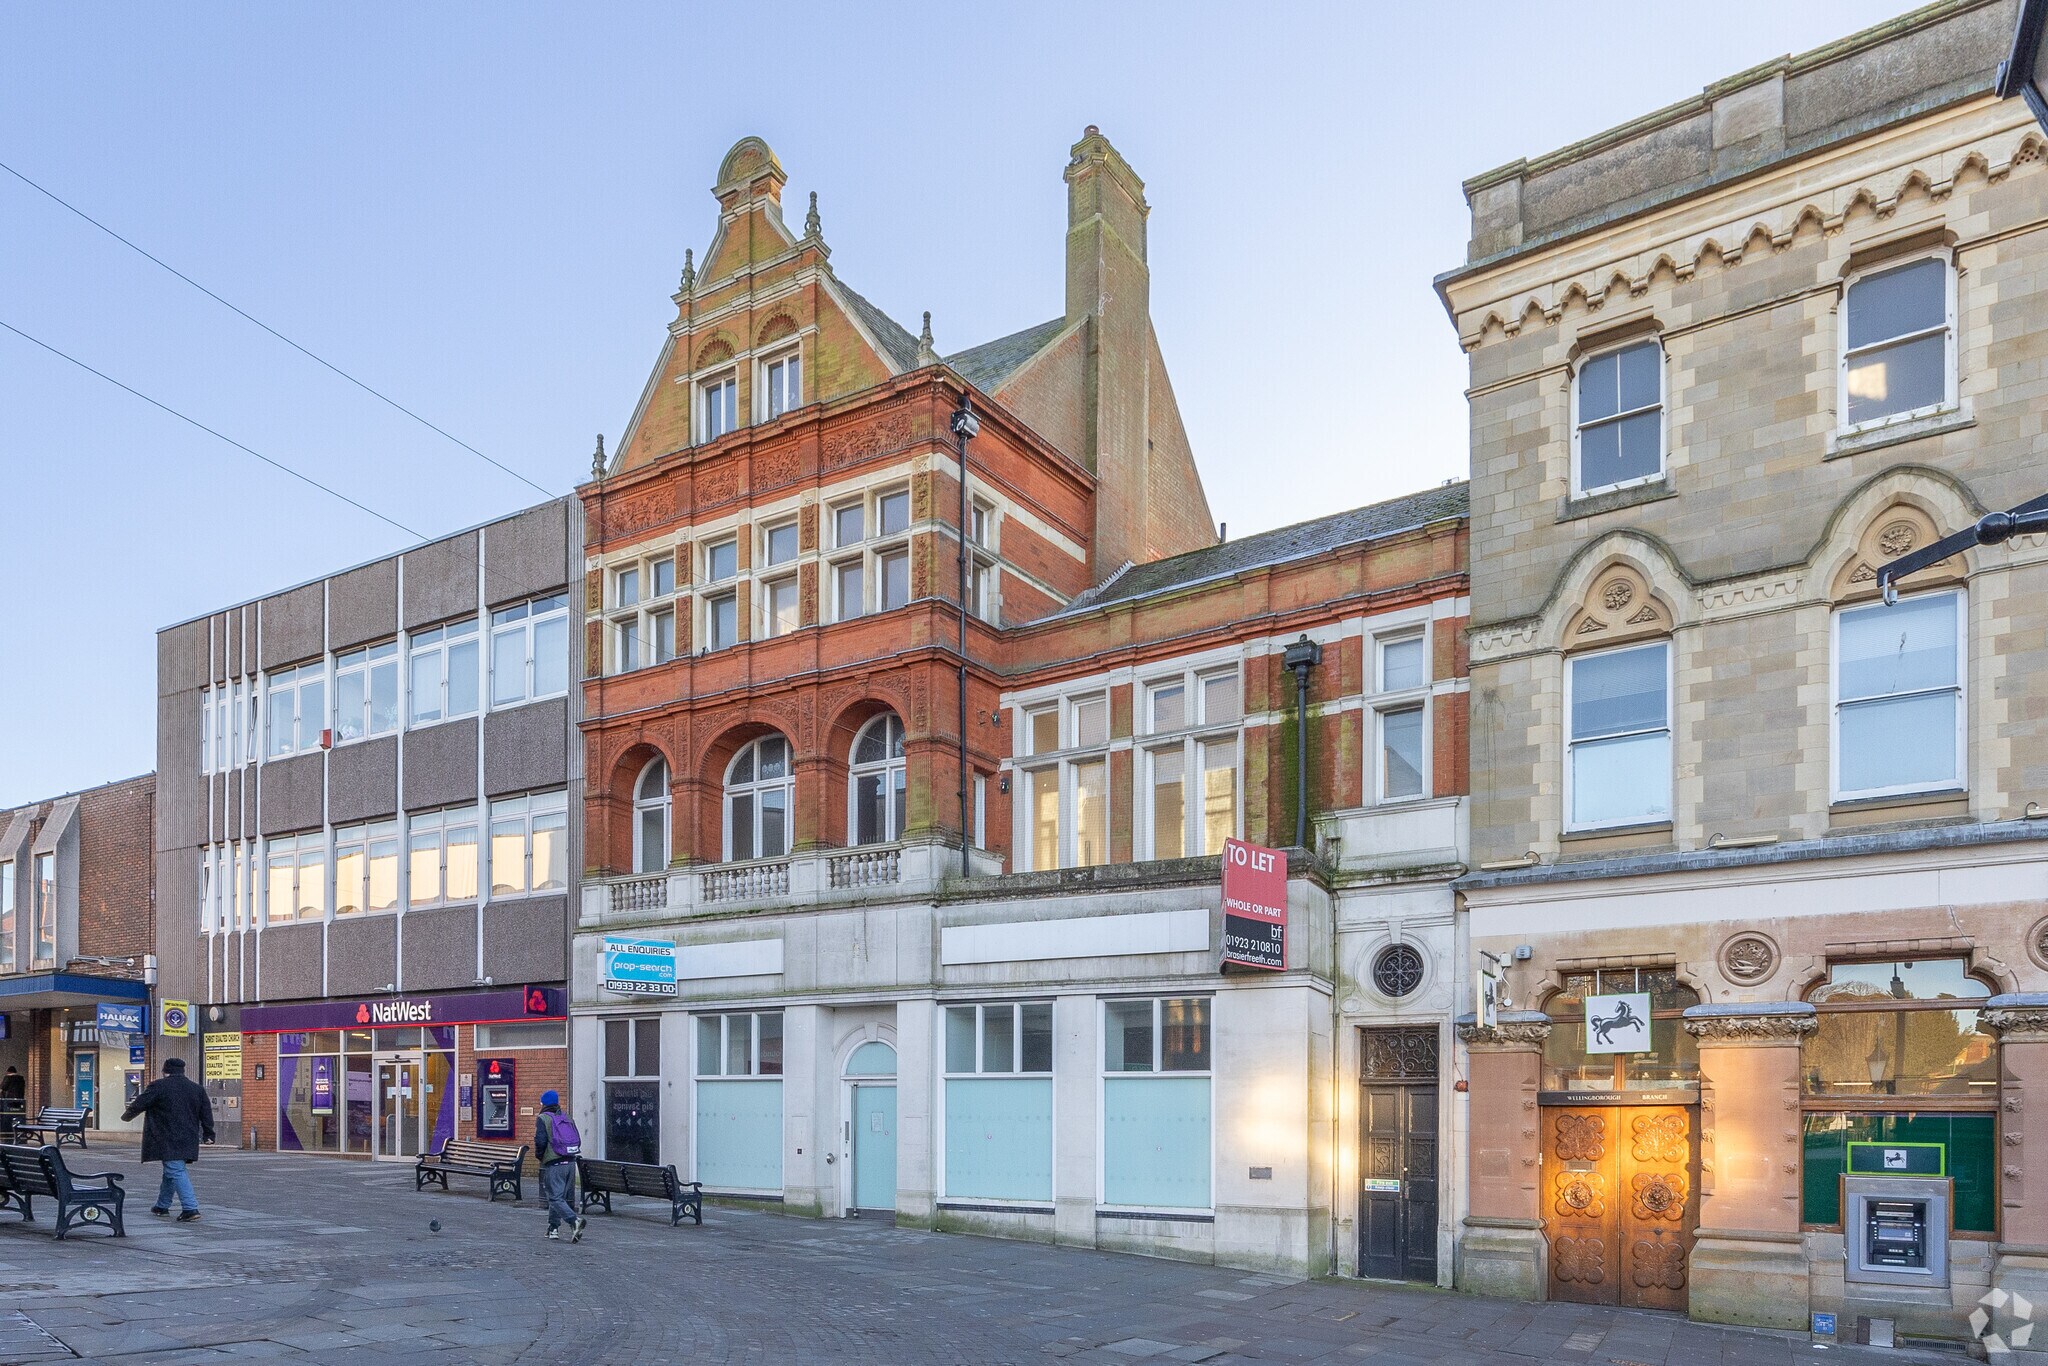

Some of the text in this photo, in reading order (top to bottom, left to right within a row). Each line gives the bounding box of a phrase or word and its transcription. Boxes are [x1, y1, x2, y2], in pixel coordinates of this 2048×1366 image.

[1228, 843, 1275, 873] TO LET
[1226, 897, 1281, 918] WHOLE OR PART
[1271, 924, 1283, 939] bf
[610, 944, 671, 956] ALL ENQUIRIES
[1226, 934, 1281, 954] 01923 210810
[1226, 947, 1282, 967] brasierfreeth.com
[613, 961, 673, 972] prop-search
[608, 980, 674, 993] 01933 22 33 00
[100, 1012, 140, 1023] HALIFAX
[372, 1000, 432, 1023] NatWest
